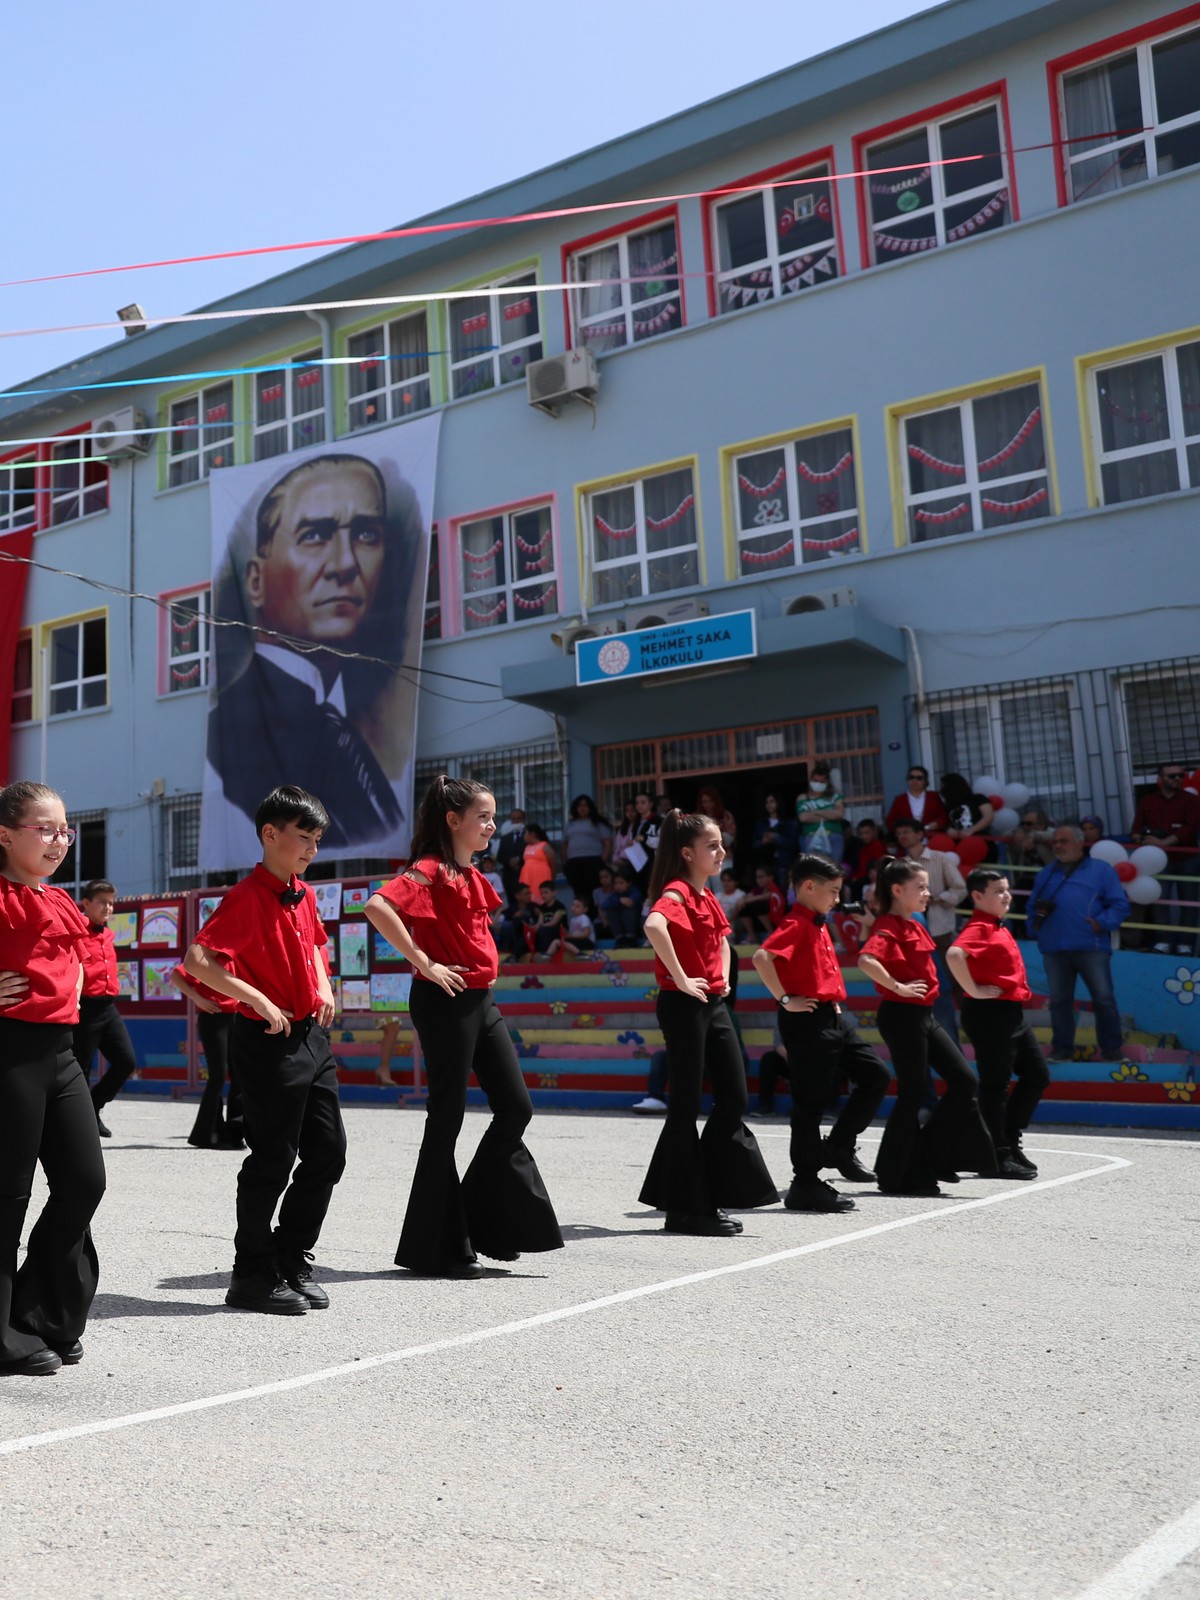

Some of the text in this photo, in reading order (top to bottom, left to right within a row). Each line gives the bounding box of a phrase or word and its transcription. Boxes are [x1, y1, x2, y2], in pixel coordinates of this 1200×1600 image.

[641, 630, 731, 655] MEHMET SAKA
[641, 649, 703, 670] İLKOKULU
